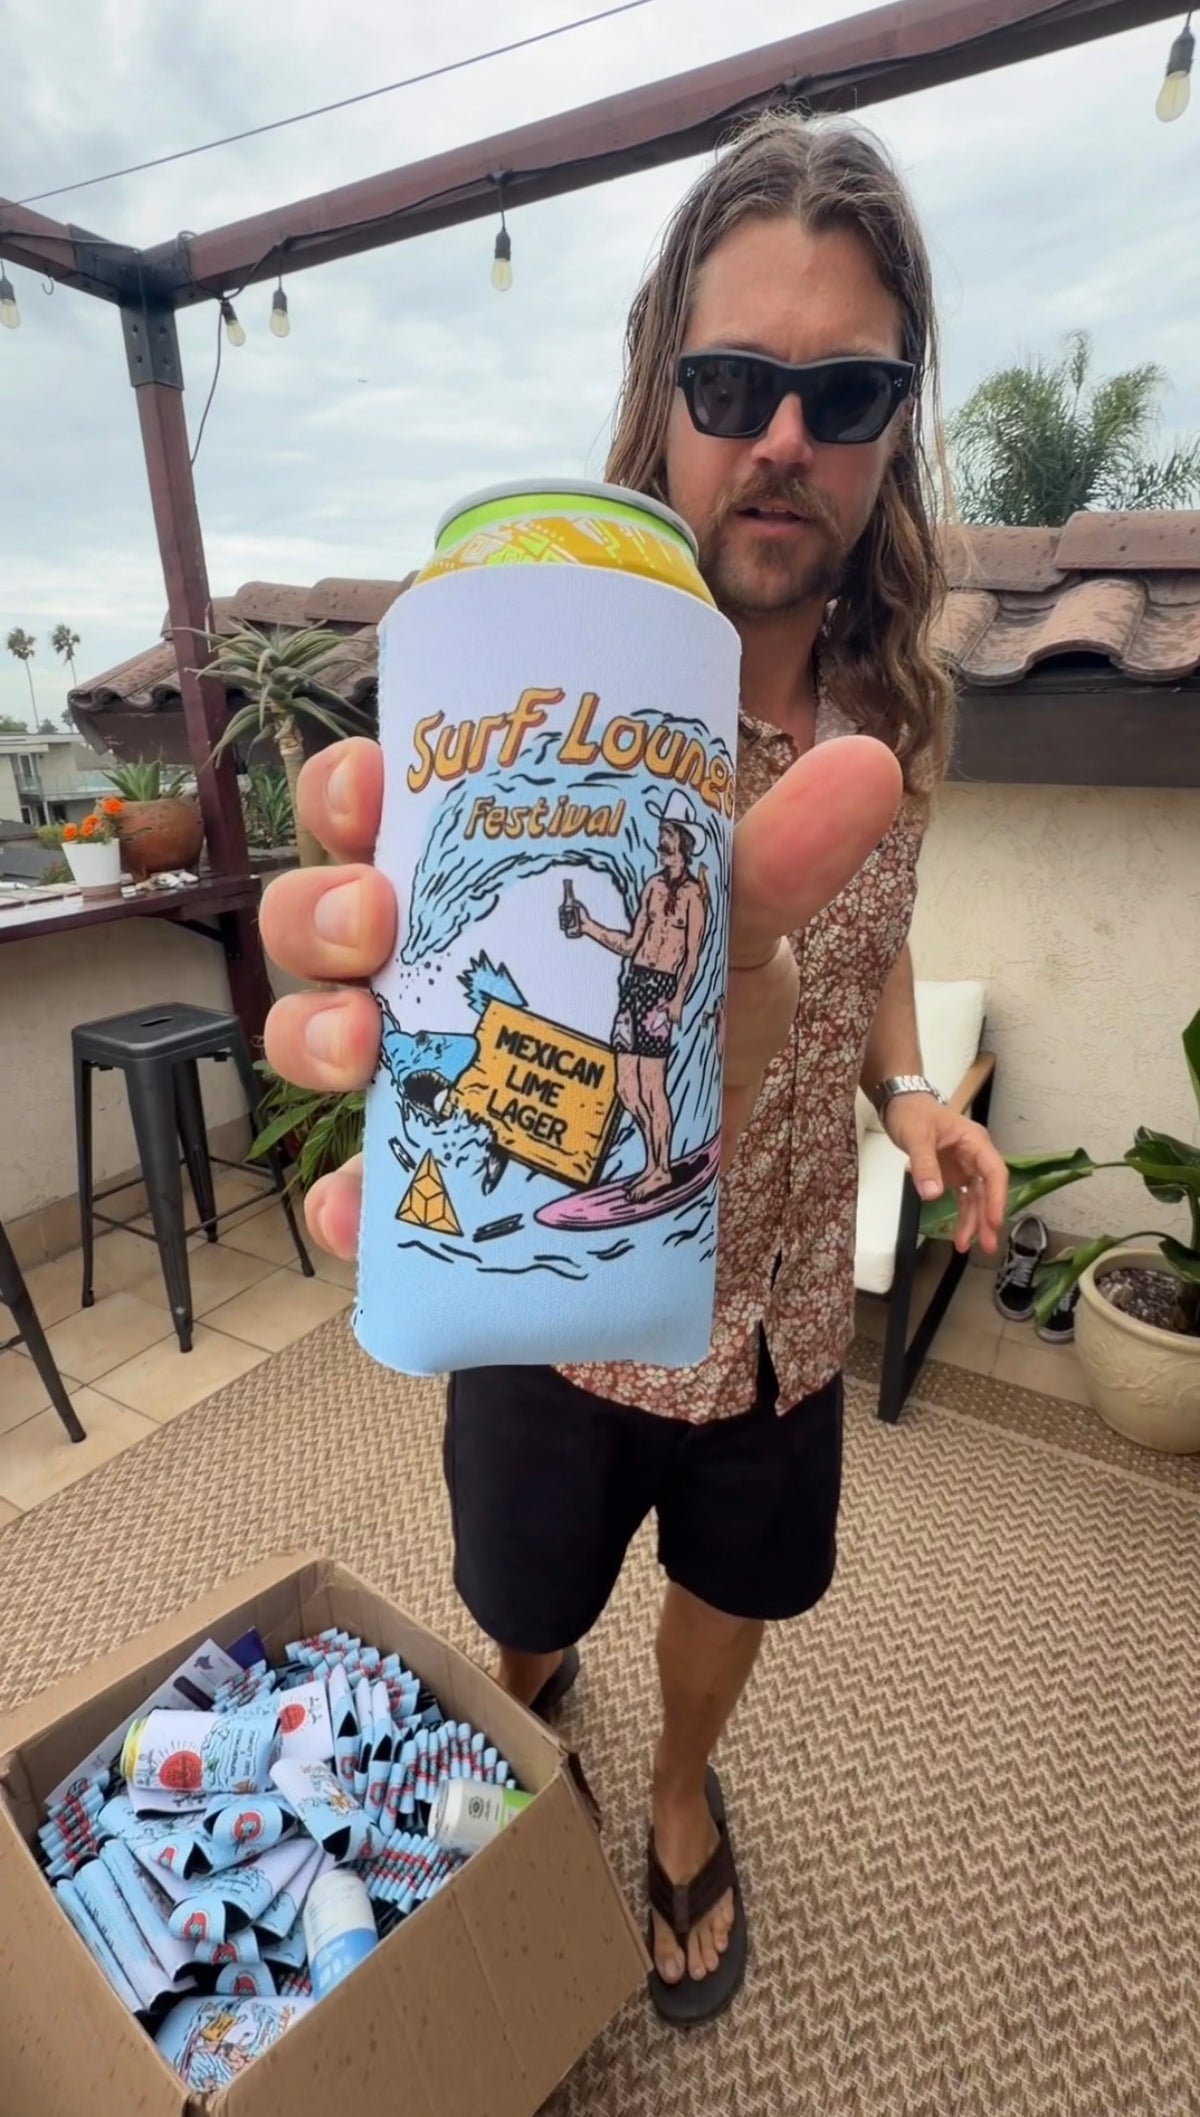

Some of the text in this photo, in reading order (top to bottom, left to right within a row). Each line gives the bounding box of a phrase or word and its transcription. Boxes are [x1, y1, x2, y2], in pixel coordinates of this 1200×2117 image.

[407, 687, 565, 793] Surf
[464, 796, 625, 839] Festival
[495, 1026, 605, 1089] MEXICAN
[505, 1065, 565, 1108] LIME
[487, 1089, 568, 1146] LAGER
